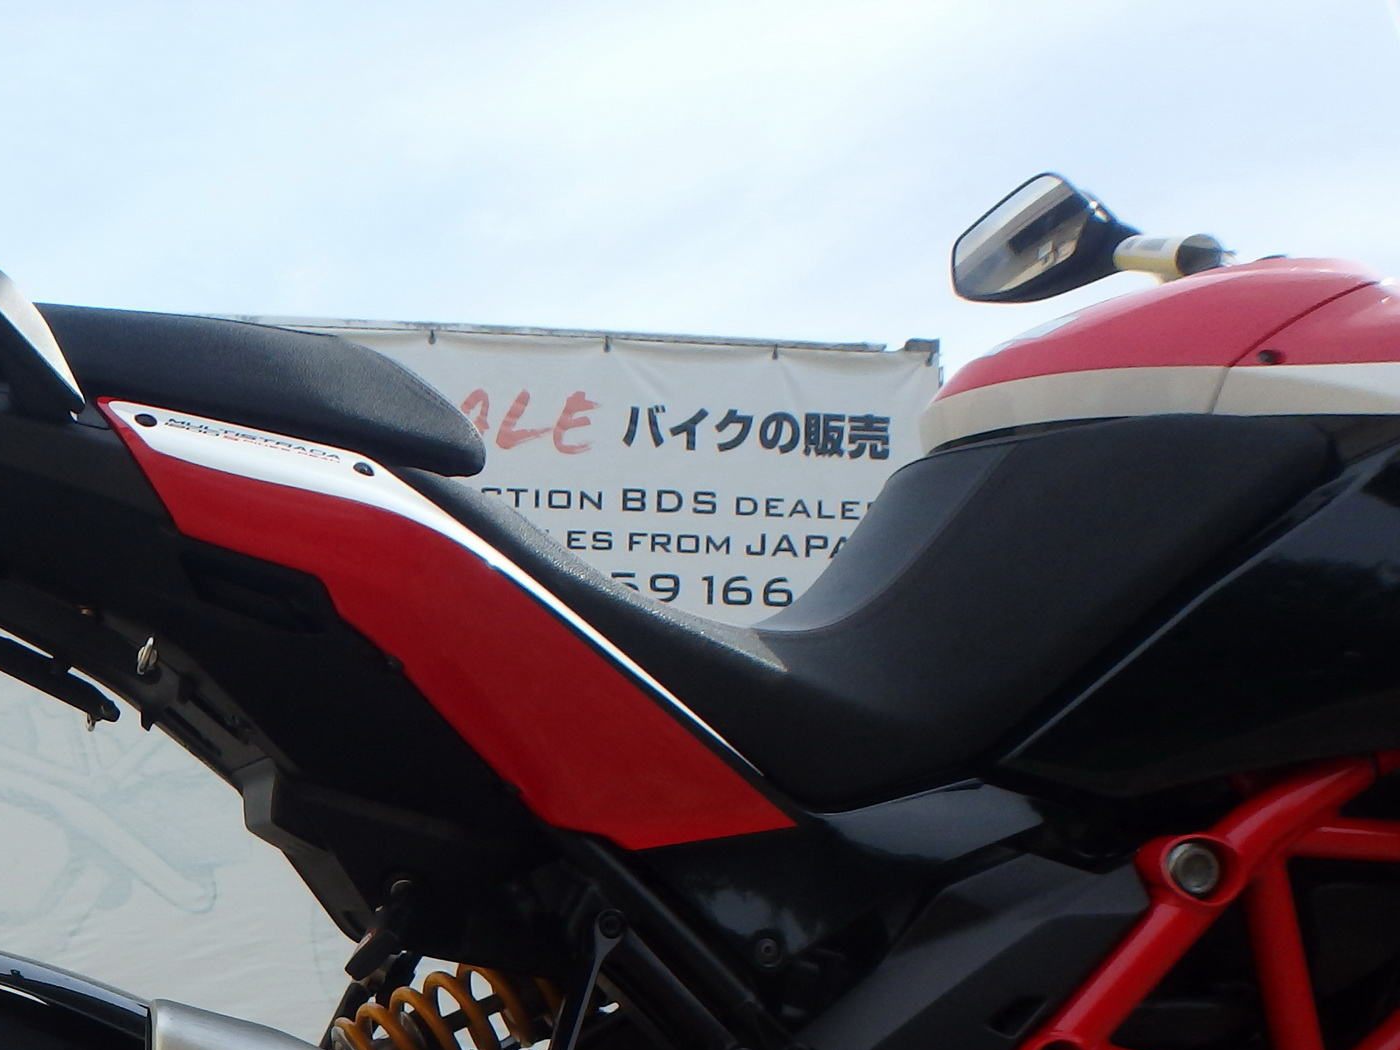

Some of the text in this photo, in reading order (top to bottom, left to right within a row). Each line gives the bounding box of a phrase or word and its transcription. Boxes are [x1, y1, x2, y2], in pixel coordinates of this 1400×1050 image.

[621, 404, 891, 461] バイクの販売
[481, 486, 876, 521] TION BDS DEALE
[545, 529, 614, 552] ES
[628, 532, 731, 556] FROM
[702, 574, 793, 607] 166
